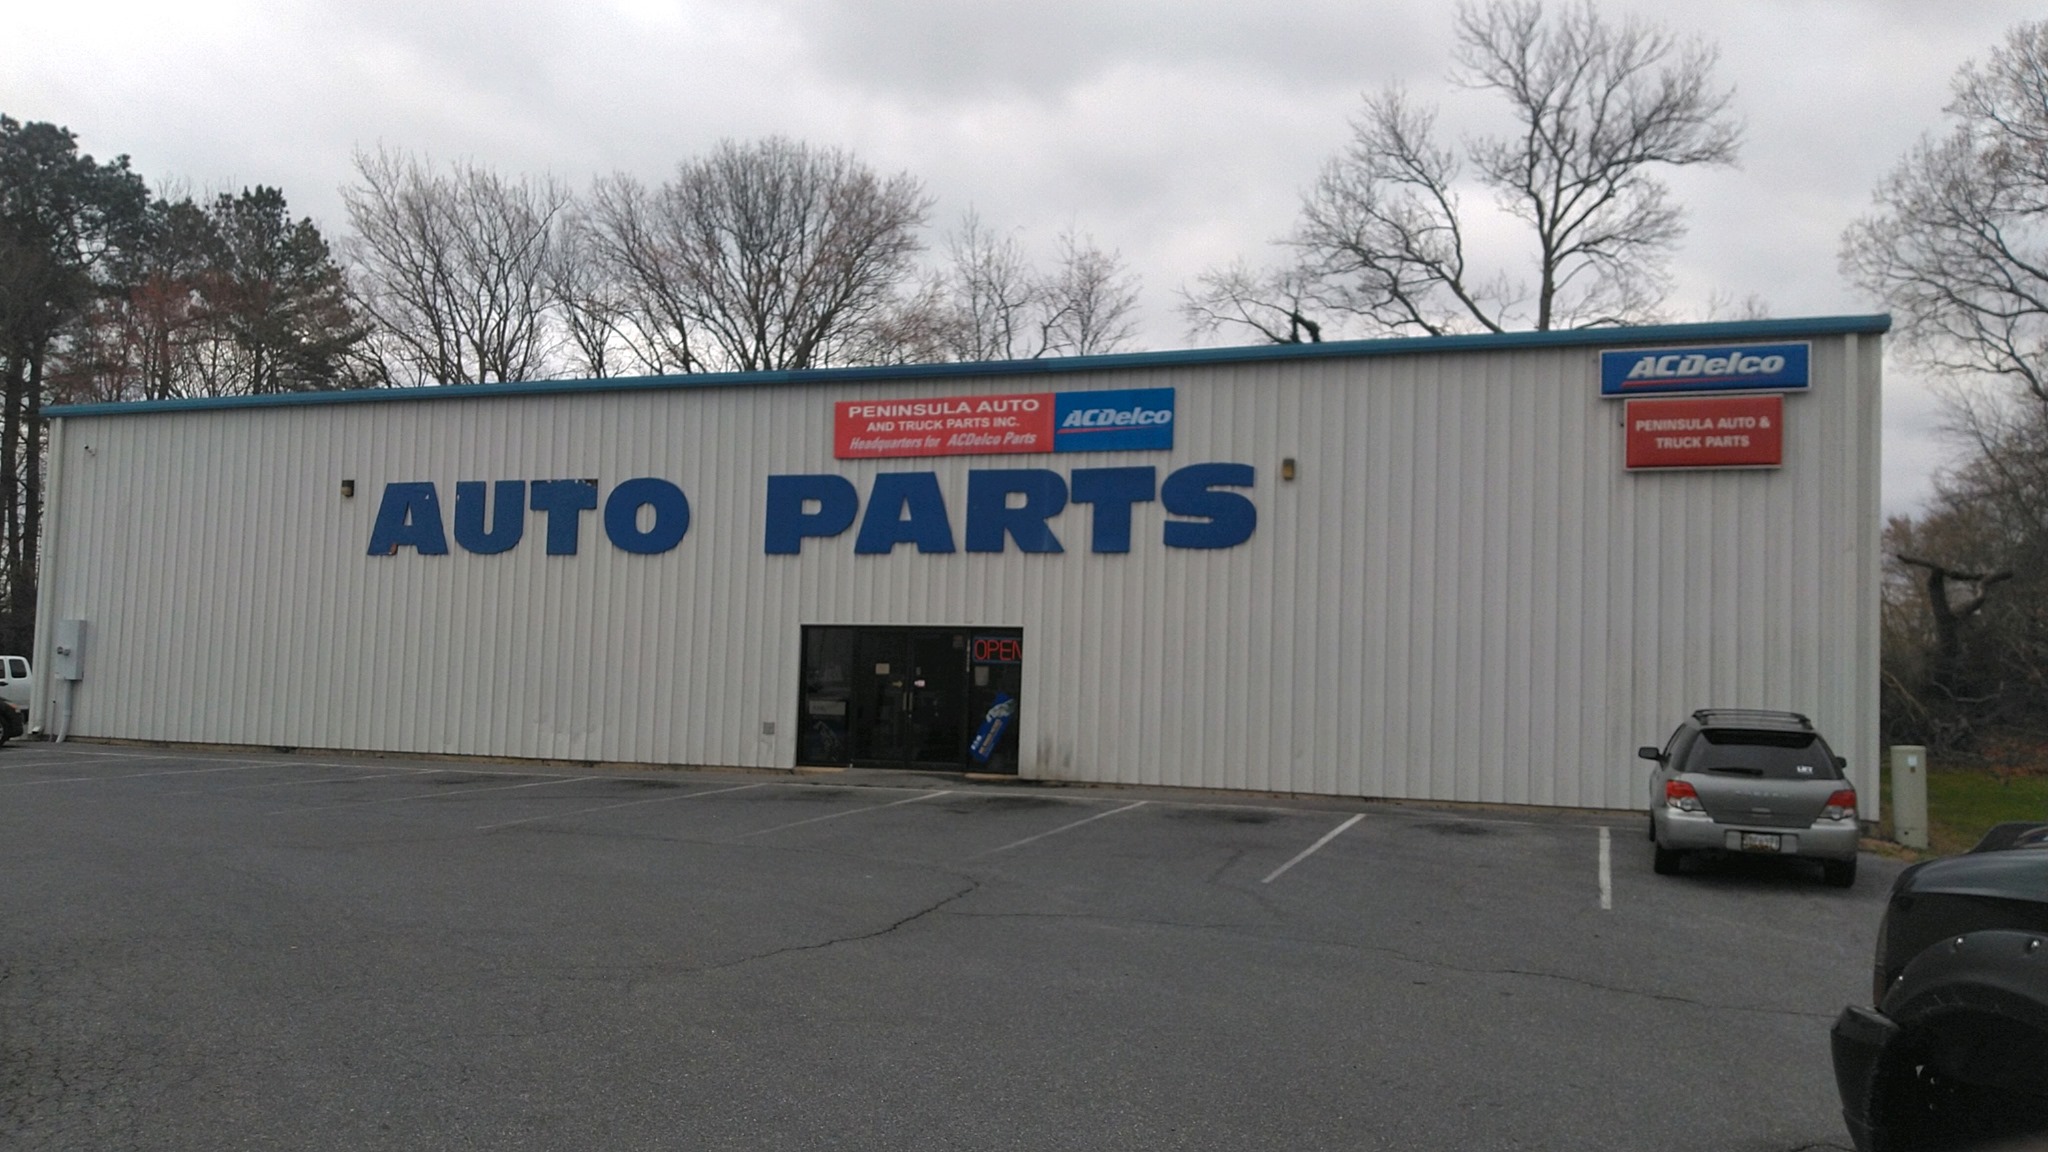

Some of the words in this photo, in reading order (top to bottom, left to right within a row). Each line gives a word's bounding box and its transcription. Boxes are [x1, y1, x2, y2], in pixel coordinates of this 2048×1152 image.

[1627, 352, 1786, 379] ACDelco
[848, 402, 972, 418] PENINSULA
[976, 399, 1039, 413] AUTO
[1062, 407, 1172, 427] ACDelco
[866, 421, 895, 432] AND
[897, 420, 943, 431] TRUCK
[946, 417, 990, 428] PARTS
[993, 416, 1020, 427] INC.
[1635, 418, 1713, 432] PENINSULA
[1717, 416, 1756, 430] AUTO
[1759, 415, 1770, 429] &
[849, 436, 923, 452] Headquarters
[924, 435, 941, 448] for
[946, 432, 1002, 446] ACDelco
[1003, 431, 1037, 445] Parts
[1655, 437, 1702, 449] TRUCK
[1705, 435, 1750, 447] PARTS
[367, 477, 690, 556] AUTO
[764, 462, 1258, 555] PARTS
[974, 639, 1023, 661] OPEN
